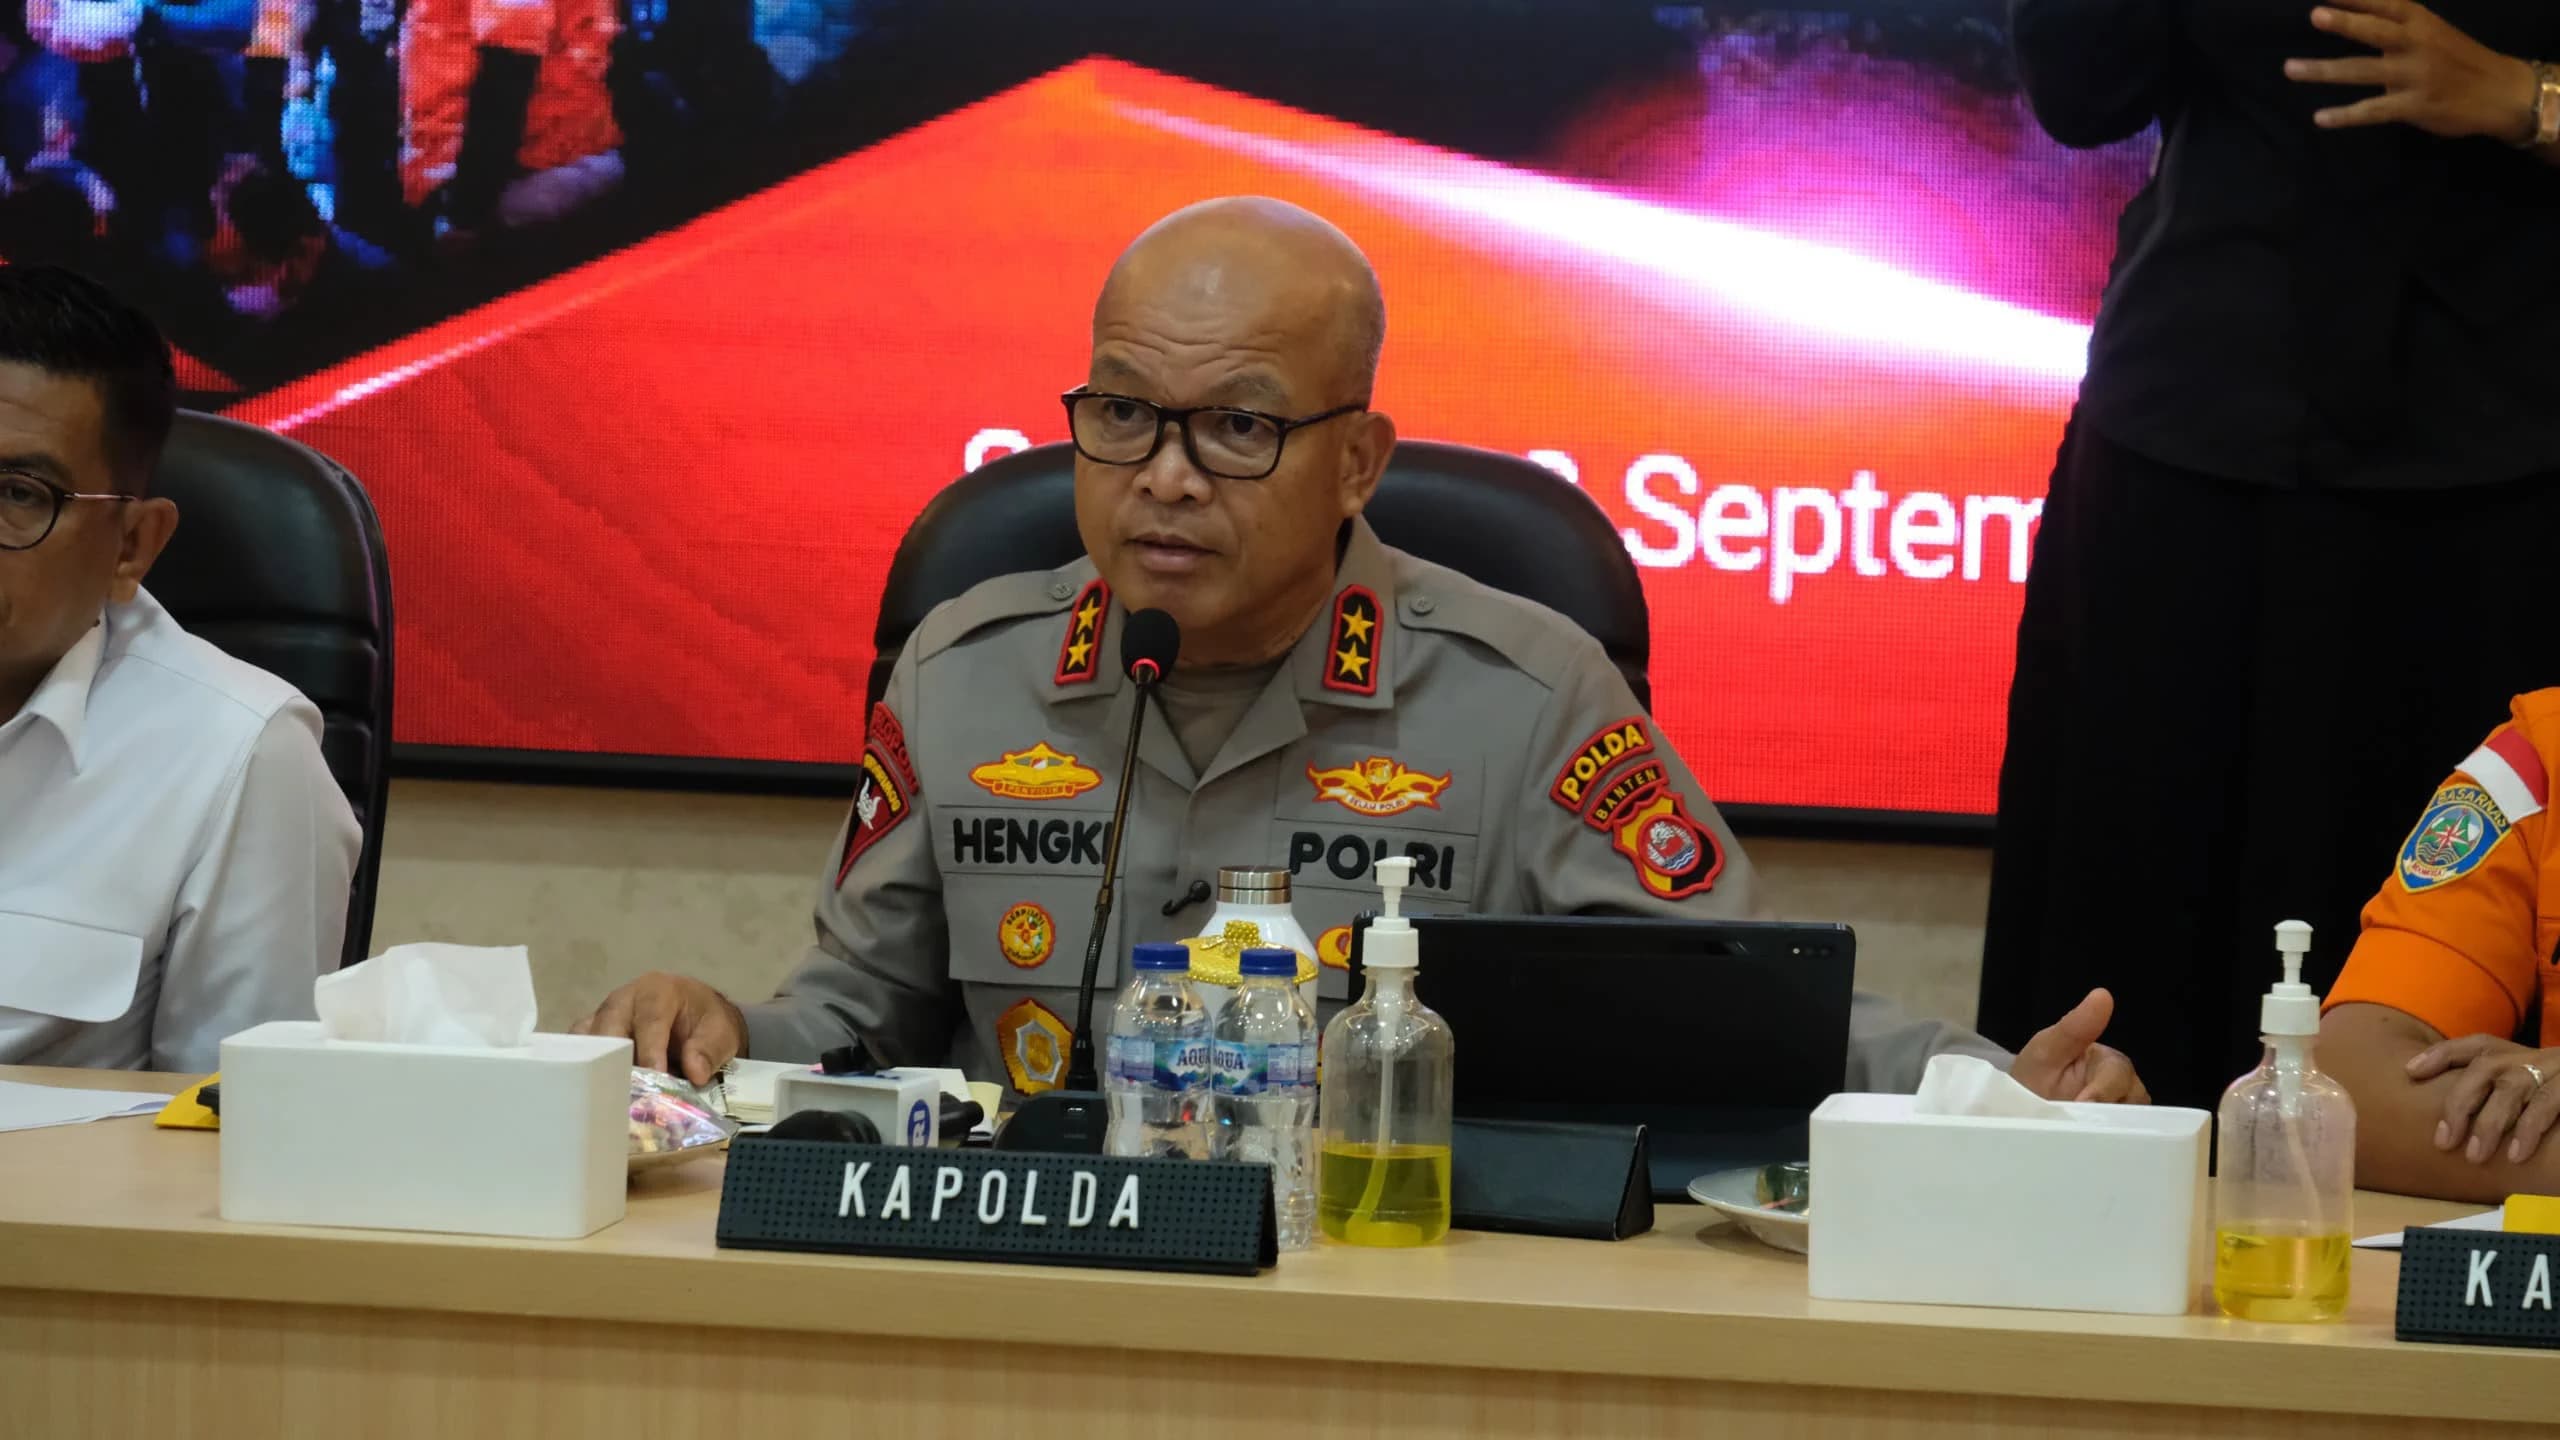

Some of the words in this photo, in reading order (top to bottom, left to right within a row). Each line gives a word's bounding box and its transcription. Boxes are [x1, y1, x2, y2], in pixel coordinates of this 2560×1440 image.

[1561, 724, 1645, 801] POLDA
[1595, 768, 1657, 820] BANTEN
[2437, 788, 2507, 828] BASARNAS
[953, 818, 1115, 865] HENGKI
[838, 1161, 1139, 1229] KAPOLDA
[2465, 1249, 2553, 1311] KA
